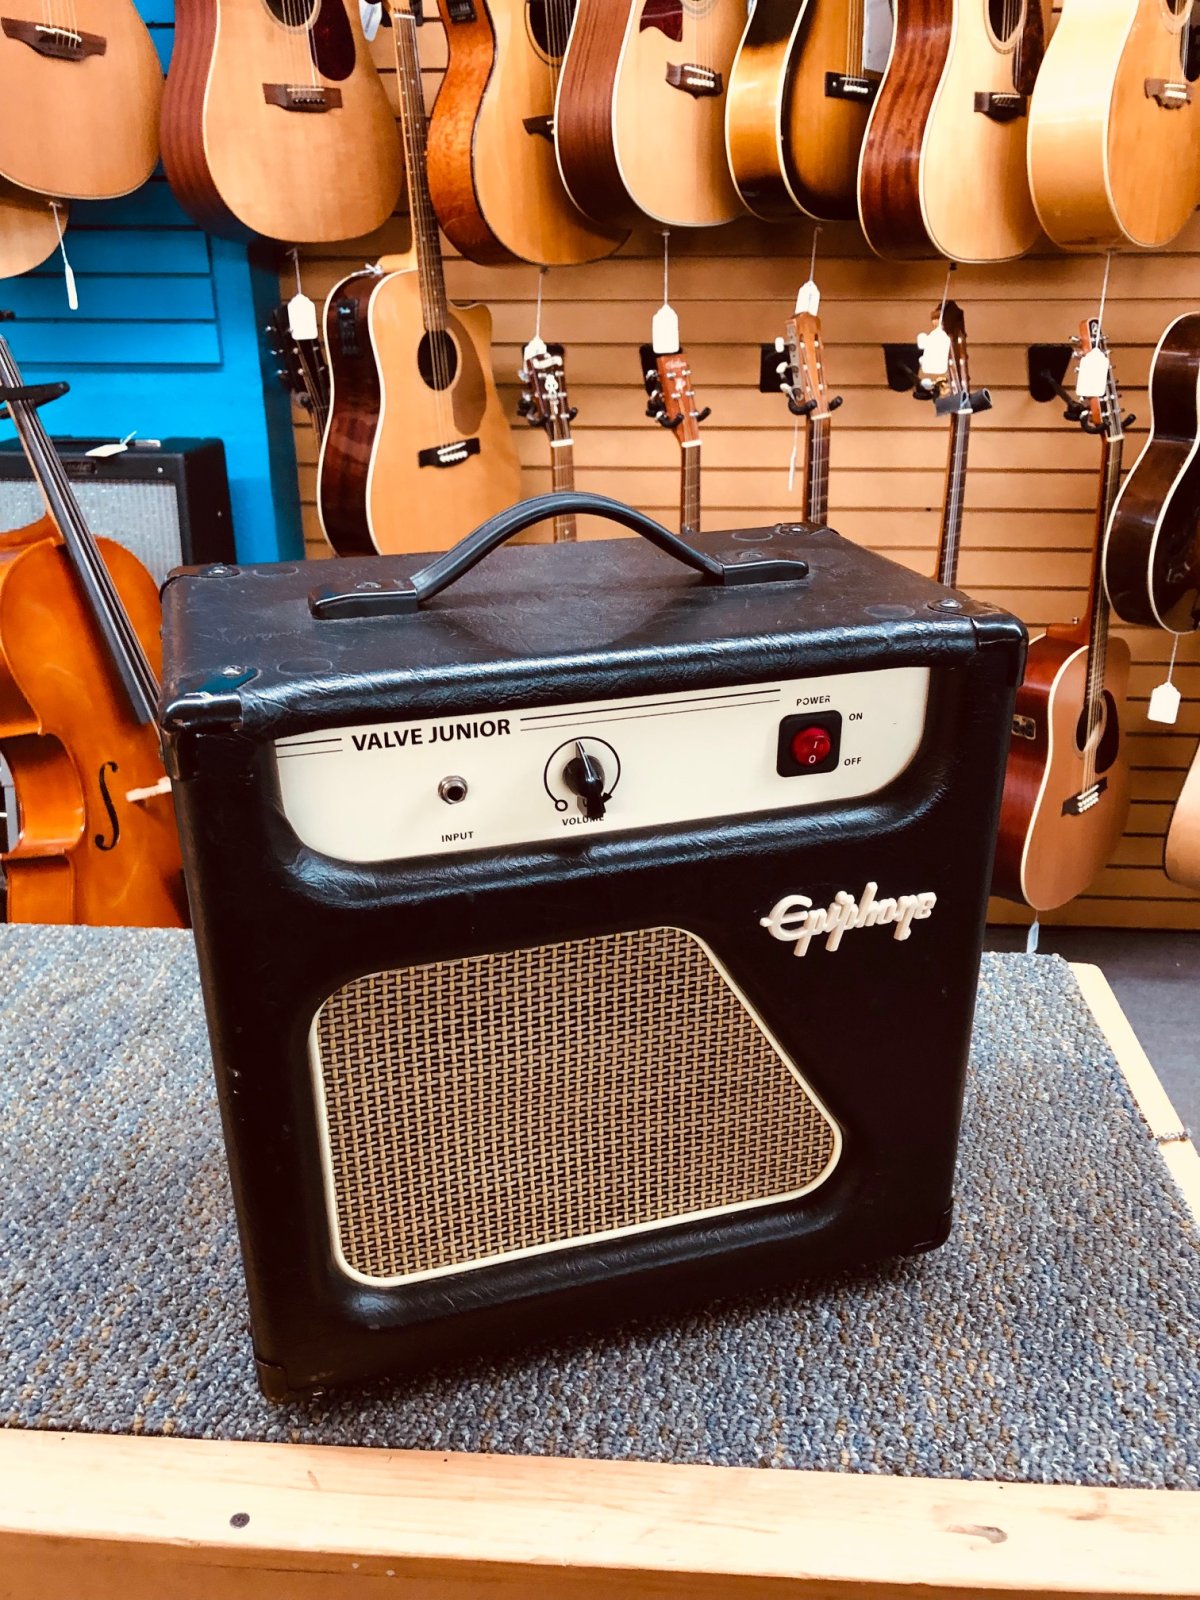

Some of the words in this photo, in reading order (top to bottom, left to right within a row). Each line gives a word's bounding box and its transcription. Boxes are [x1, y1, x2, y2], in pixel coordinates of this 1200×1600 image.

[796, 694, 831, 706] POWER
[848, 712, 863, 721] ON
[351, 728, 423, 751] VALVE
[428, 719, 511, 743] JUNIOR
[843, 757, 862, 766] OFF
[441, 831, 474, 842] INPUT
[760, 881, 937, 957] Epiphone
